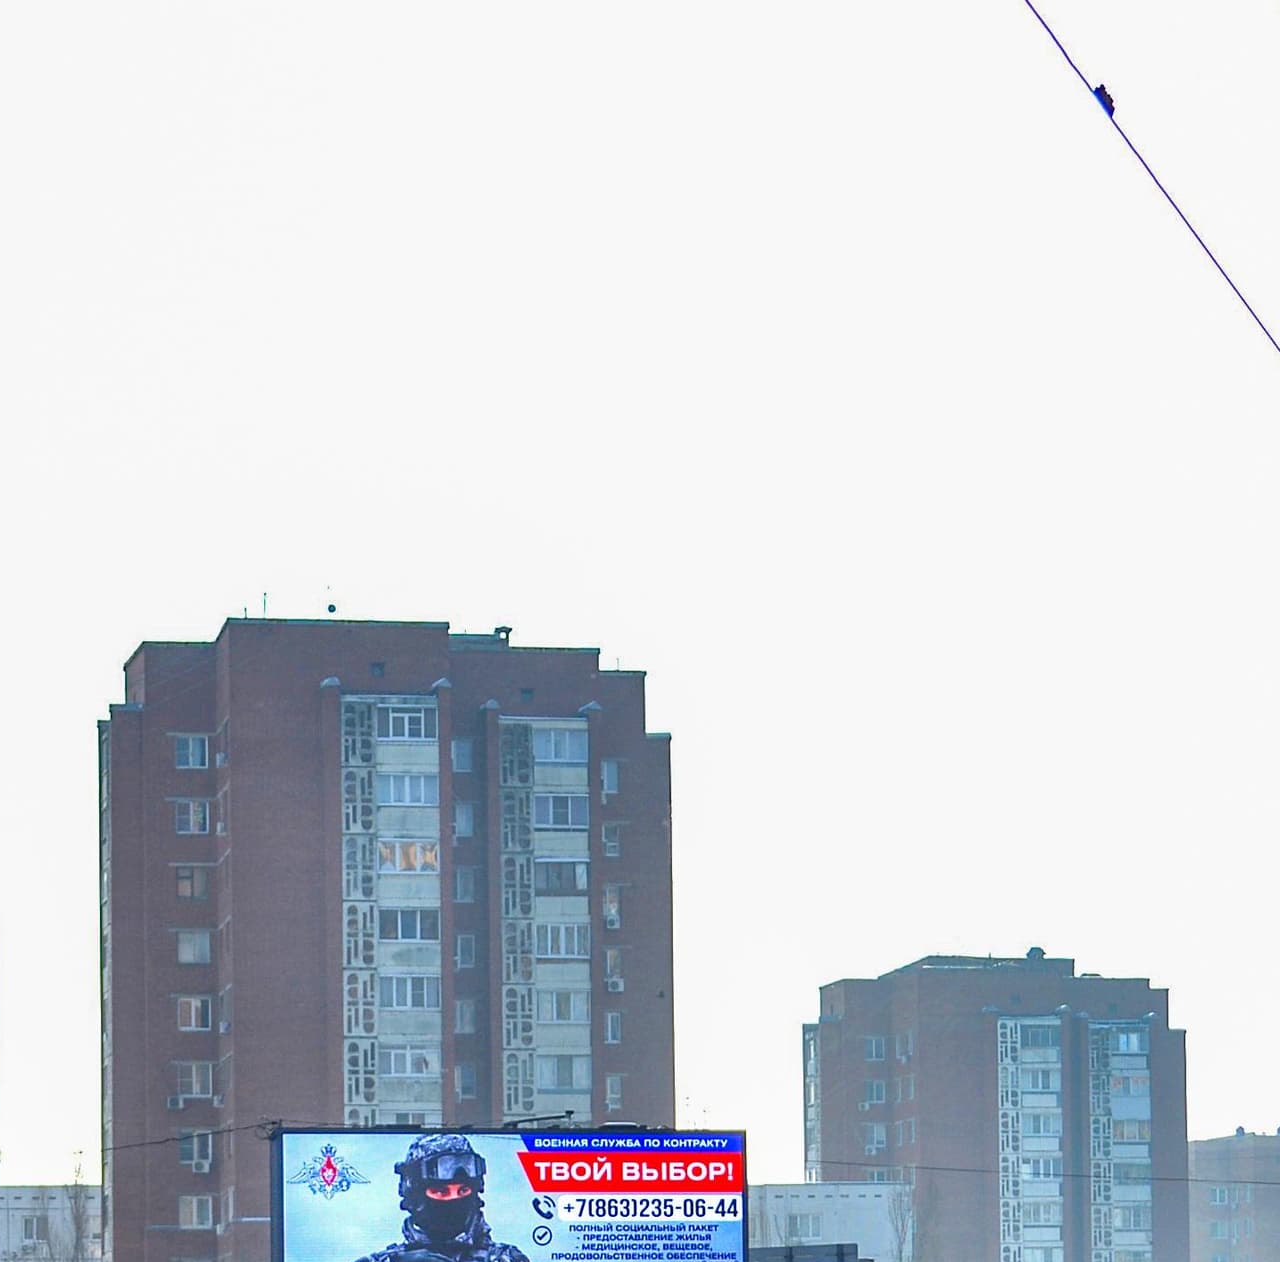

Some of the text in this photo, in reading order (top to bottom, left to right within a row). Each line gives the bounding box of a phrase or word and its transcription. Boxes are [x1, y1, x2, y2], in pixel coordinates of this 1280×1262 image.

[534, 1138, 728, 1148] ВОЕННАЯ СЛУЖБА ПО КОНТРАКТУ
[534, 1156, 734, 1181] ТВОЙ ВЫБОР!
[563, 1198, 738, 1218] +7(863)235-06-44
[569, 1224, 719, 1233] ПОЛНЫЙ СОЦИАЛЬНЫЙ ПАКЕТ
[583, 1234, 673, 1242] ПРЕДОСТАВЛЕНИЕ
[676, 1234, 712, 1242] ЖИЛЬЯ
[581, 1243, 661, 1252] МЕДИЦИНСКОЕ,
[663, 1243, 713, 1252] ВЕЩЕВОЕ,
[551, 1252, 737, 1260] ПРОДОВОЛЬСТВЕННОЕ ОБЕСПЕЧЕНИЕ
